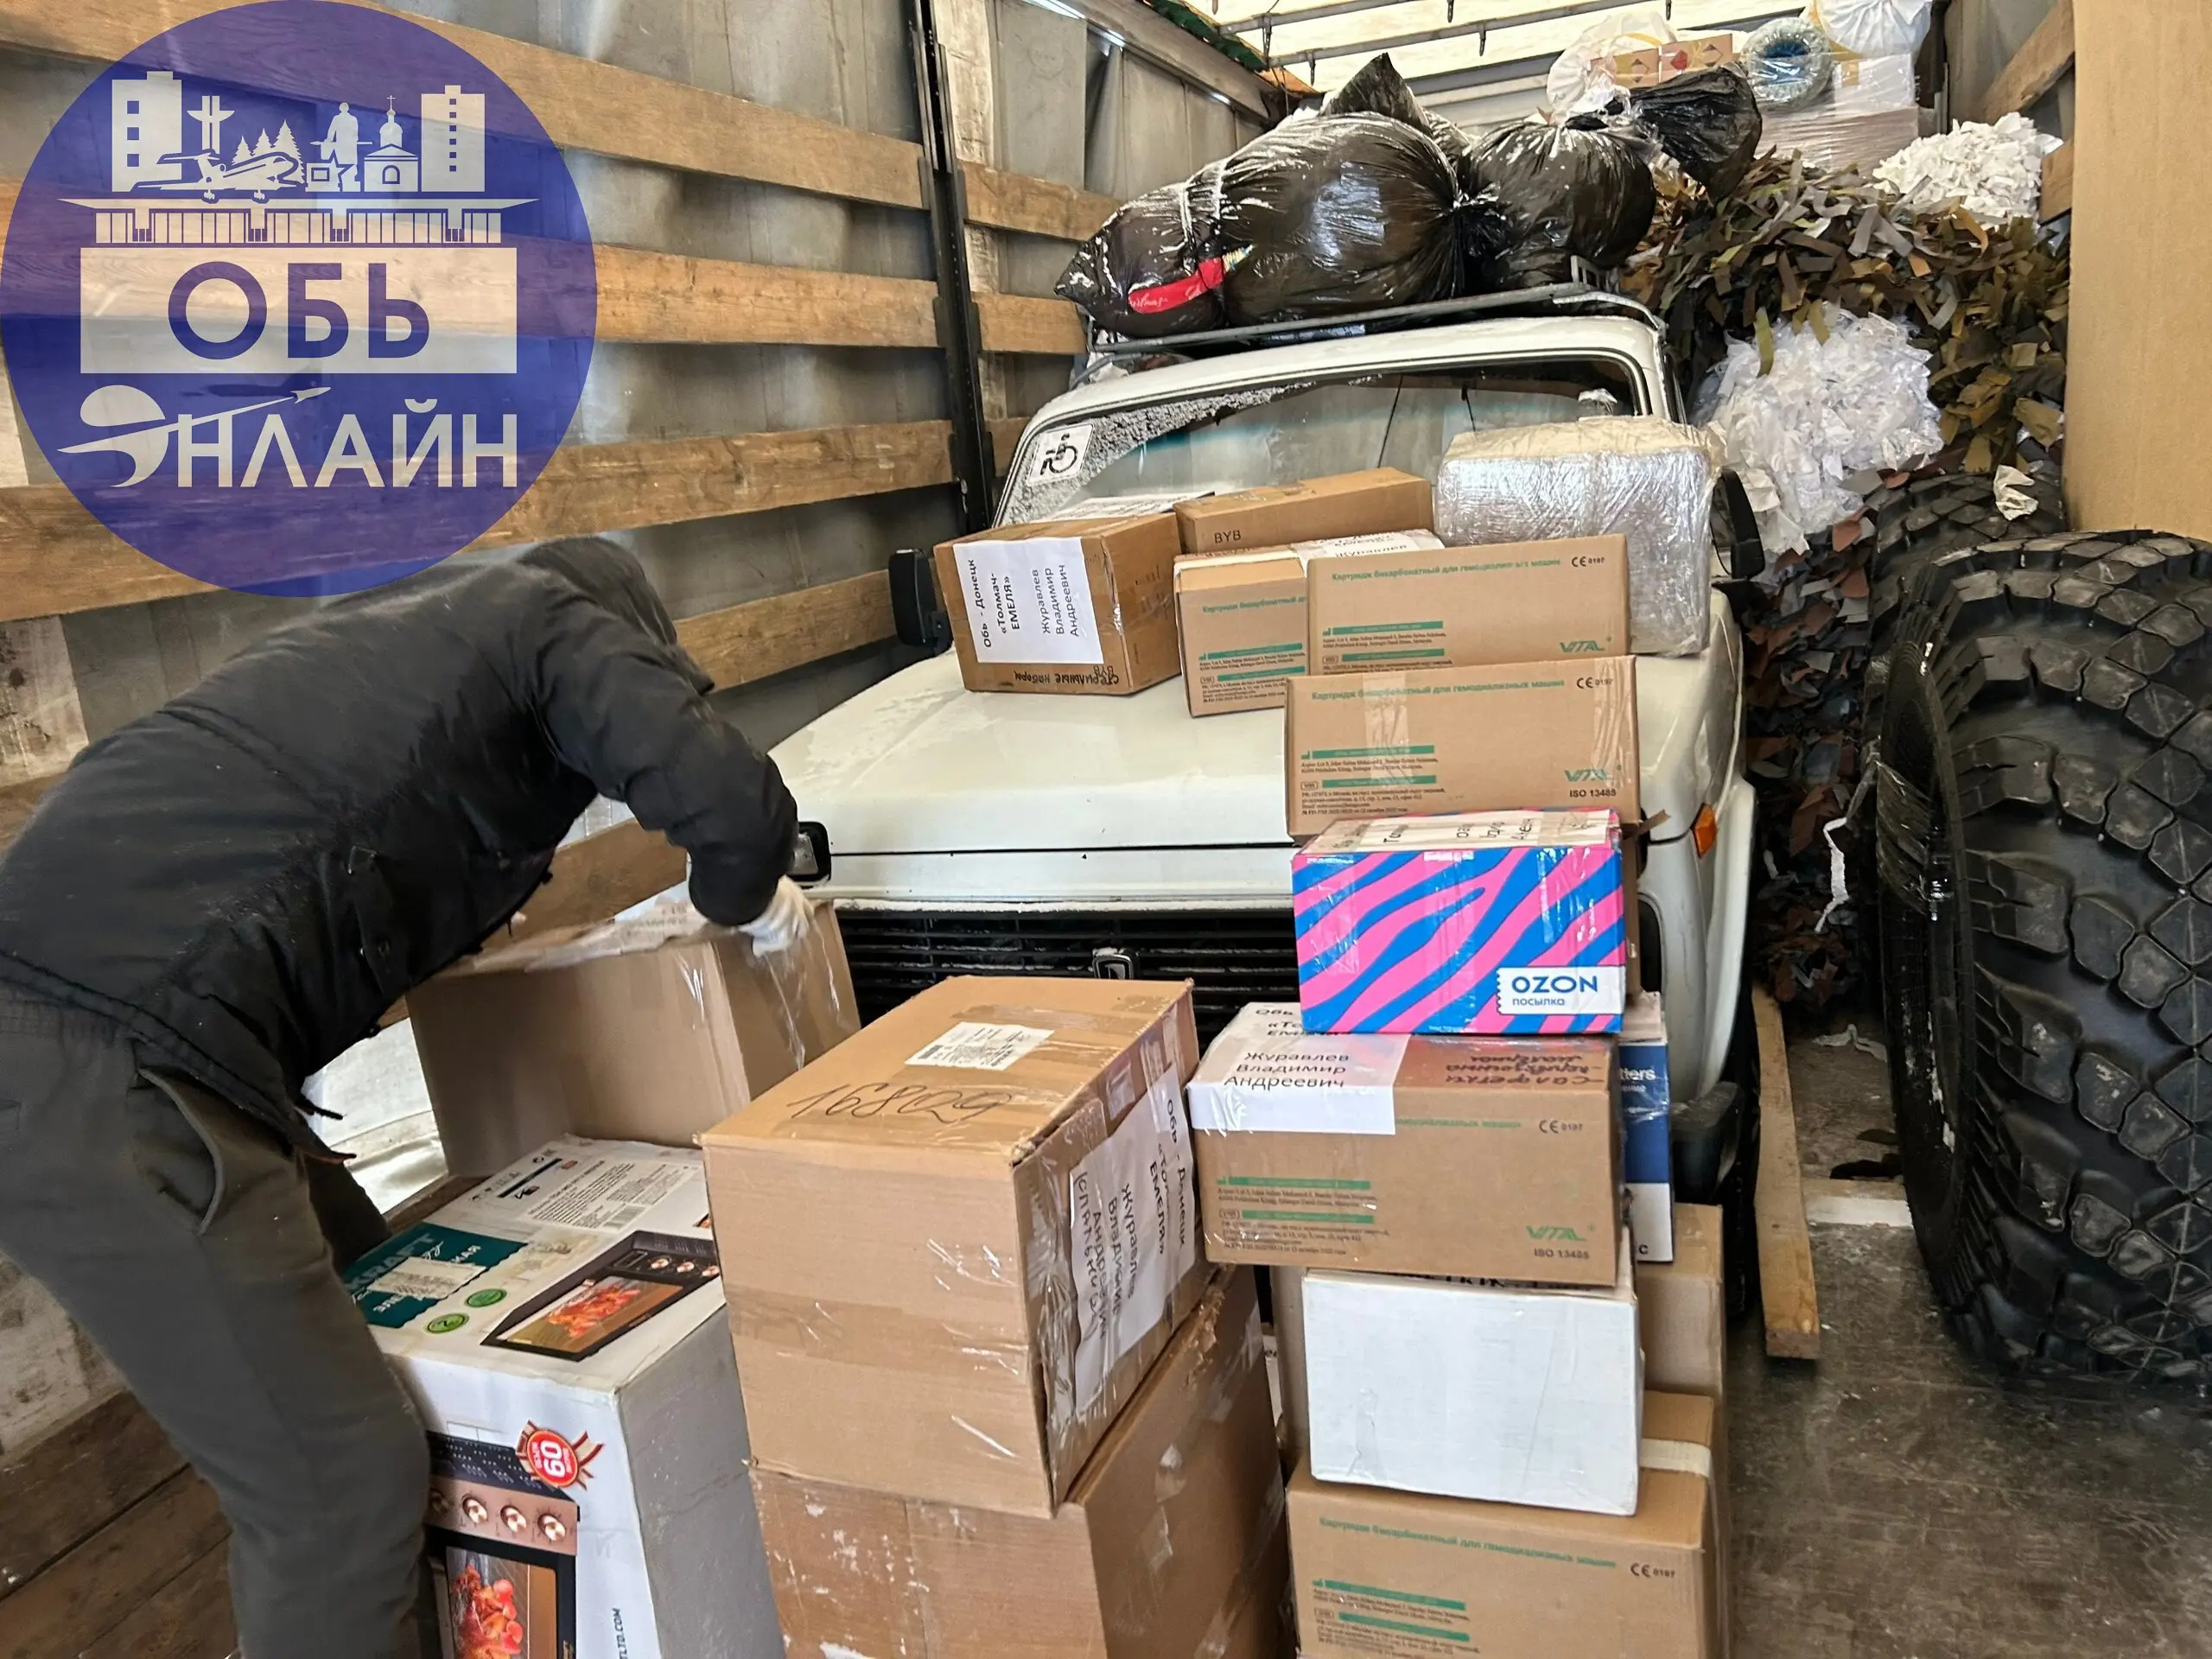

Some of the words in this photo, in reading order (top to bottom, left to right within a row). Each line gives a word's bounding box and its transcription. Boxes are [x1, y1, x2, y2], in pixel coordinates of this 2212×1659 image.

[968, 559, 985, 609] Донецк
[1332, 570, 1372, 582] Картридж
[1003, 576, 1020, 630] ЕМЕЛЯ»
[1032, 569, 1051, 634] Журавлев
[1045, 568, 1065, 635] Владимир
[1058, 564, 1079, 638] Андреевич
[980, 622, 991, 648] Обь
[1569, 790, 1586, 798] ISO
[1589, 789, 1617, 798] 13485
[1511, 975, 1598, 993] OZON
[1512, 997, 1566, 1007] посылка
[1236, 1064, 1347, 1074] Владимир
[1243, 1052, 1350, 1064] Журавлев
[1224, 1075, 1345, 1091] Андреевич
[1166, 1098, 1178, 1144] Обь
[1149, 1160, 1166, 1255] ЕМЕЛЯ»
[1534, 1248, 1554, 1258] ISO
[540, 1440, 567, 1478] 60
